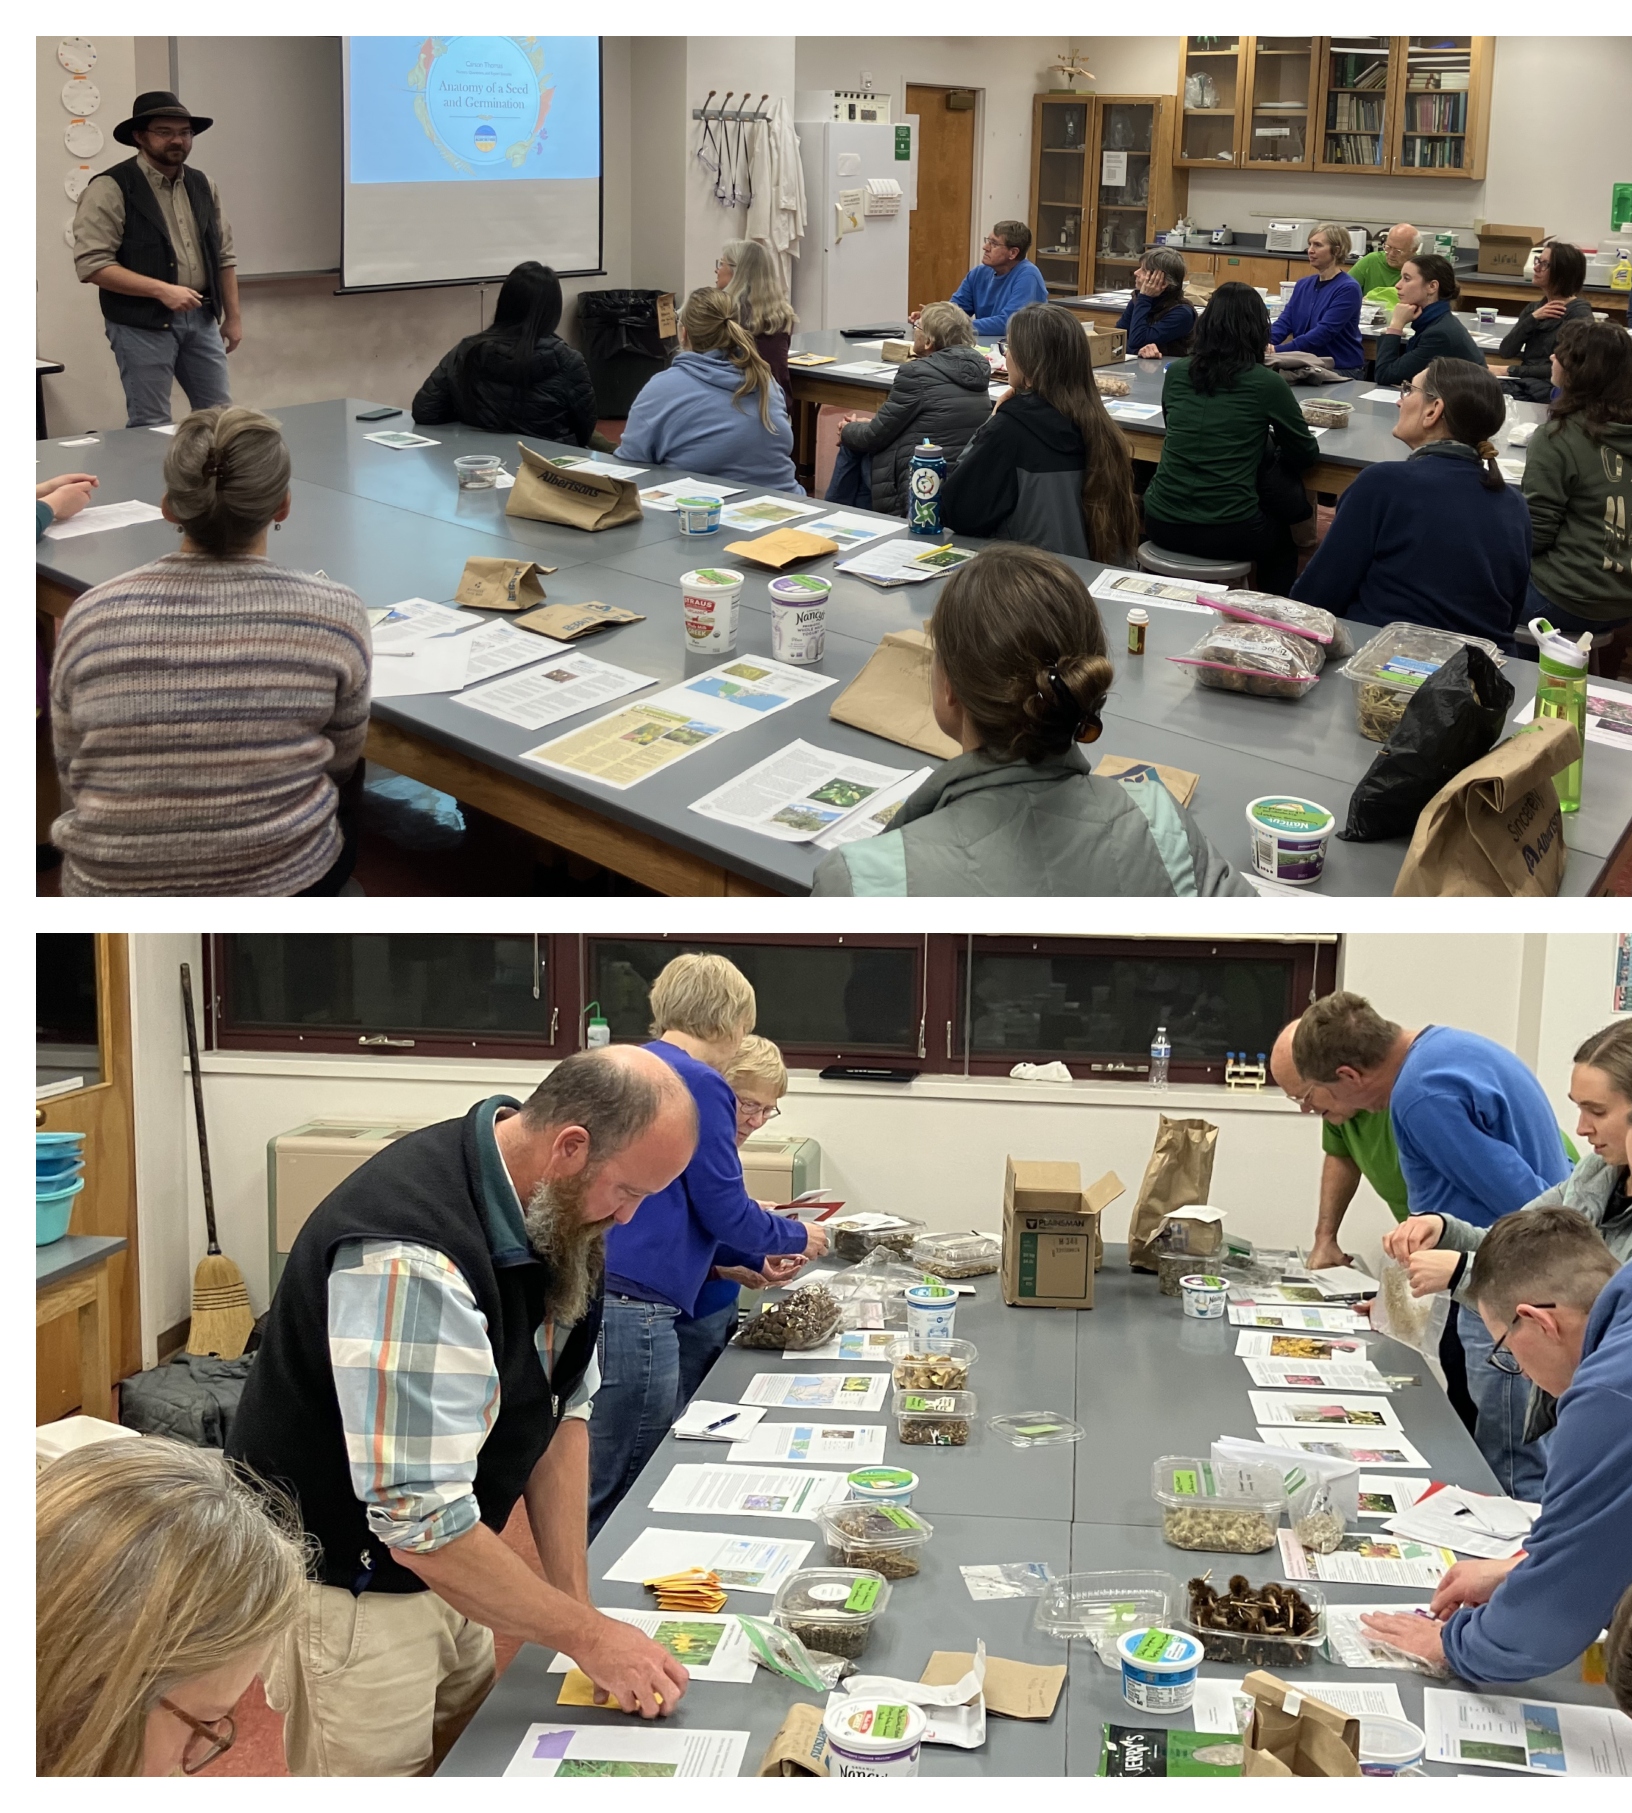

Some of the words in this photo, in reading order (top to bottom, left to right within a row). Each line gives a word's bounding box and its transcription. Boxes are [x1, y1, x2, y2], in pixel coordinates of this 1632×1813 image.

[439, 81, 483, 95] Anatomy
[486, 83, 496, 93] of
[506, 83, 528, 94] Seed
[444, 97, 461, 107] and
[466, 97, 525, 108] Germination
[538, 471, 600, 497] Albertsons
[796, 611, 825, 625] Nancy's
[1125, 1734, 1144, 1771] JERRY'S
